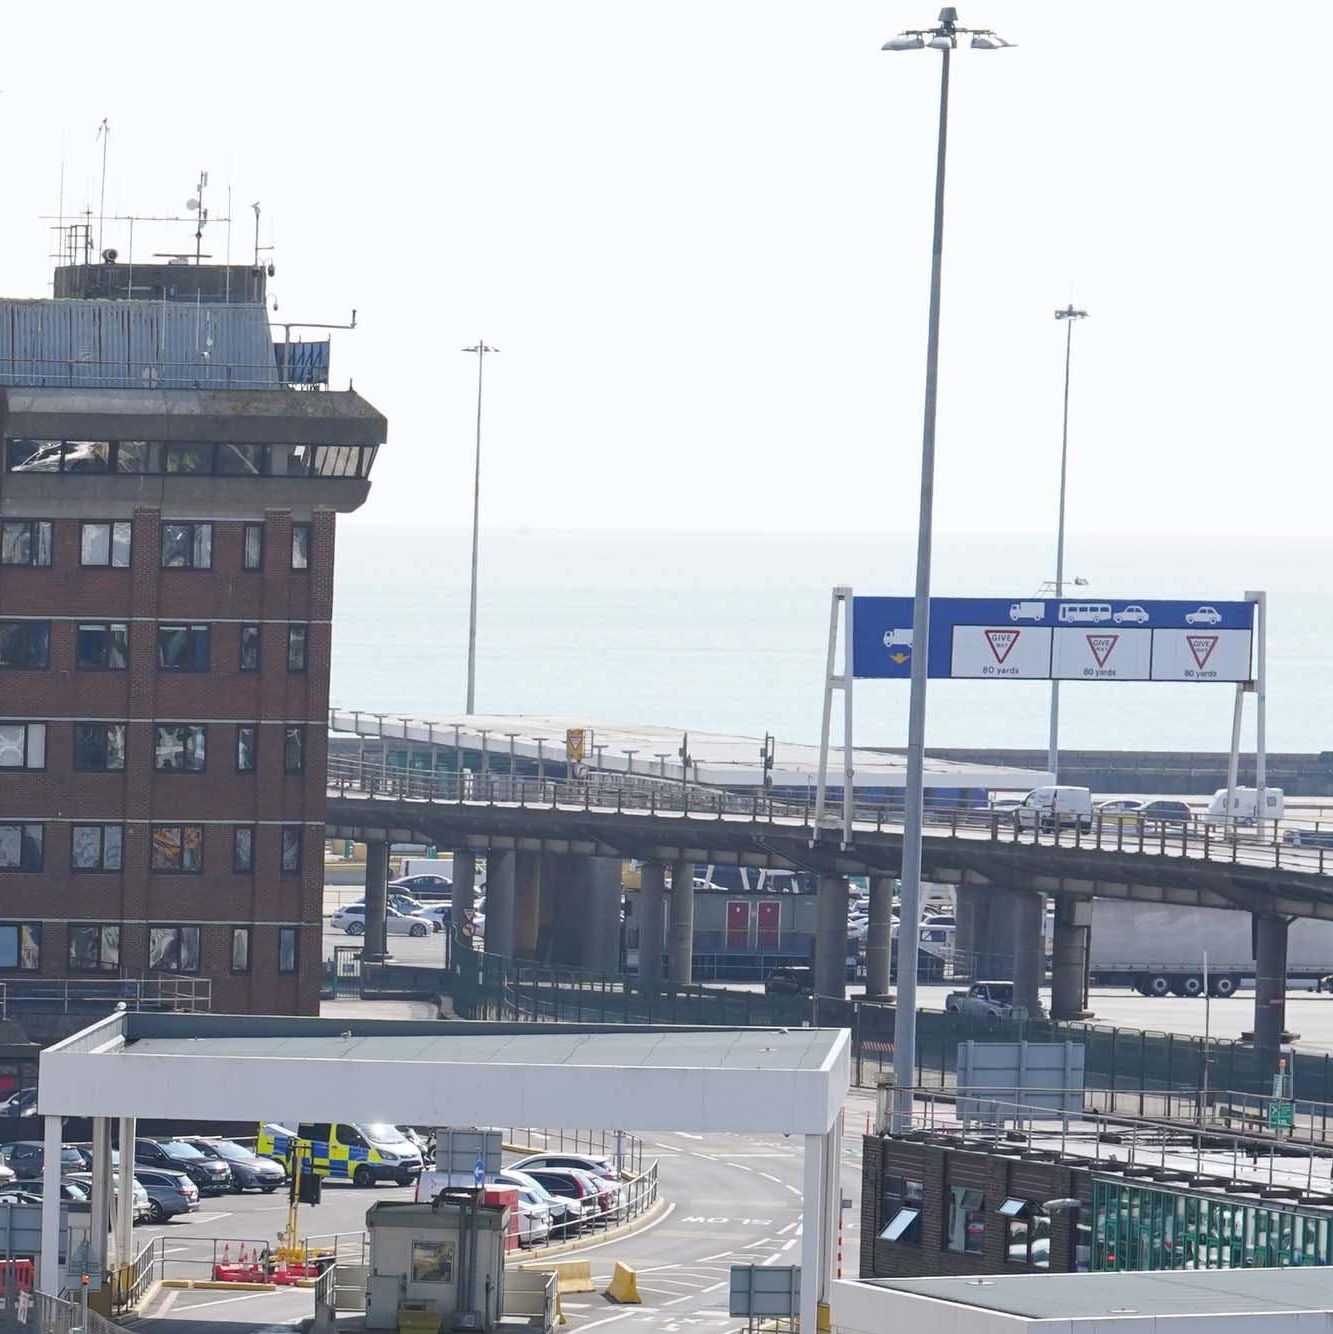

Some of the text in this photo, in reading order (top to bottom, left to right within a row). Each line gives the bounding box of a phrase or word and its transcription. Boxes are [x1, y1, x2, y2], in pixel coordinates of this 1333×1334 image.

[992, 634, 1012, 643] GIVE
[1193, 640, 1210, 648] GIVE
[983, 666, 1019, 677] 80 yards
[1084, 668, 1117, 679] 80 yards
[1185, 669, 1218, 679] 80 yards
